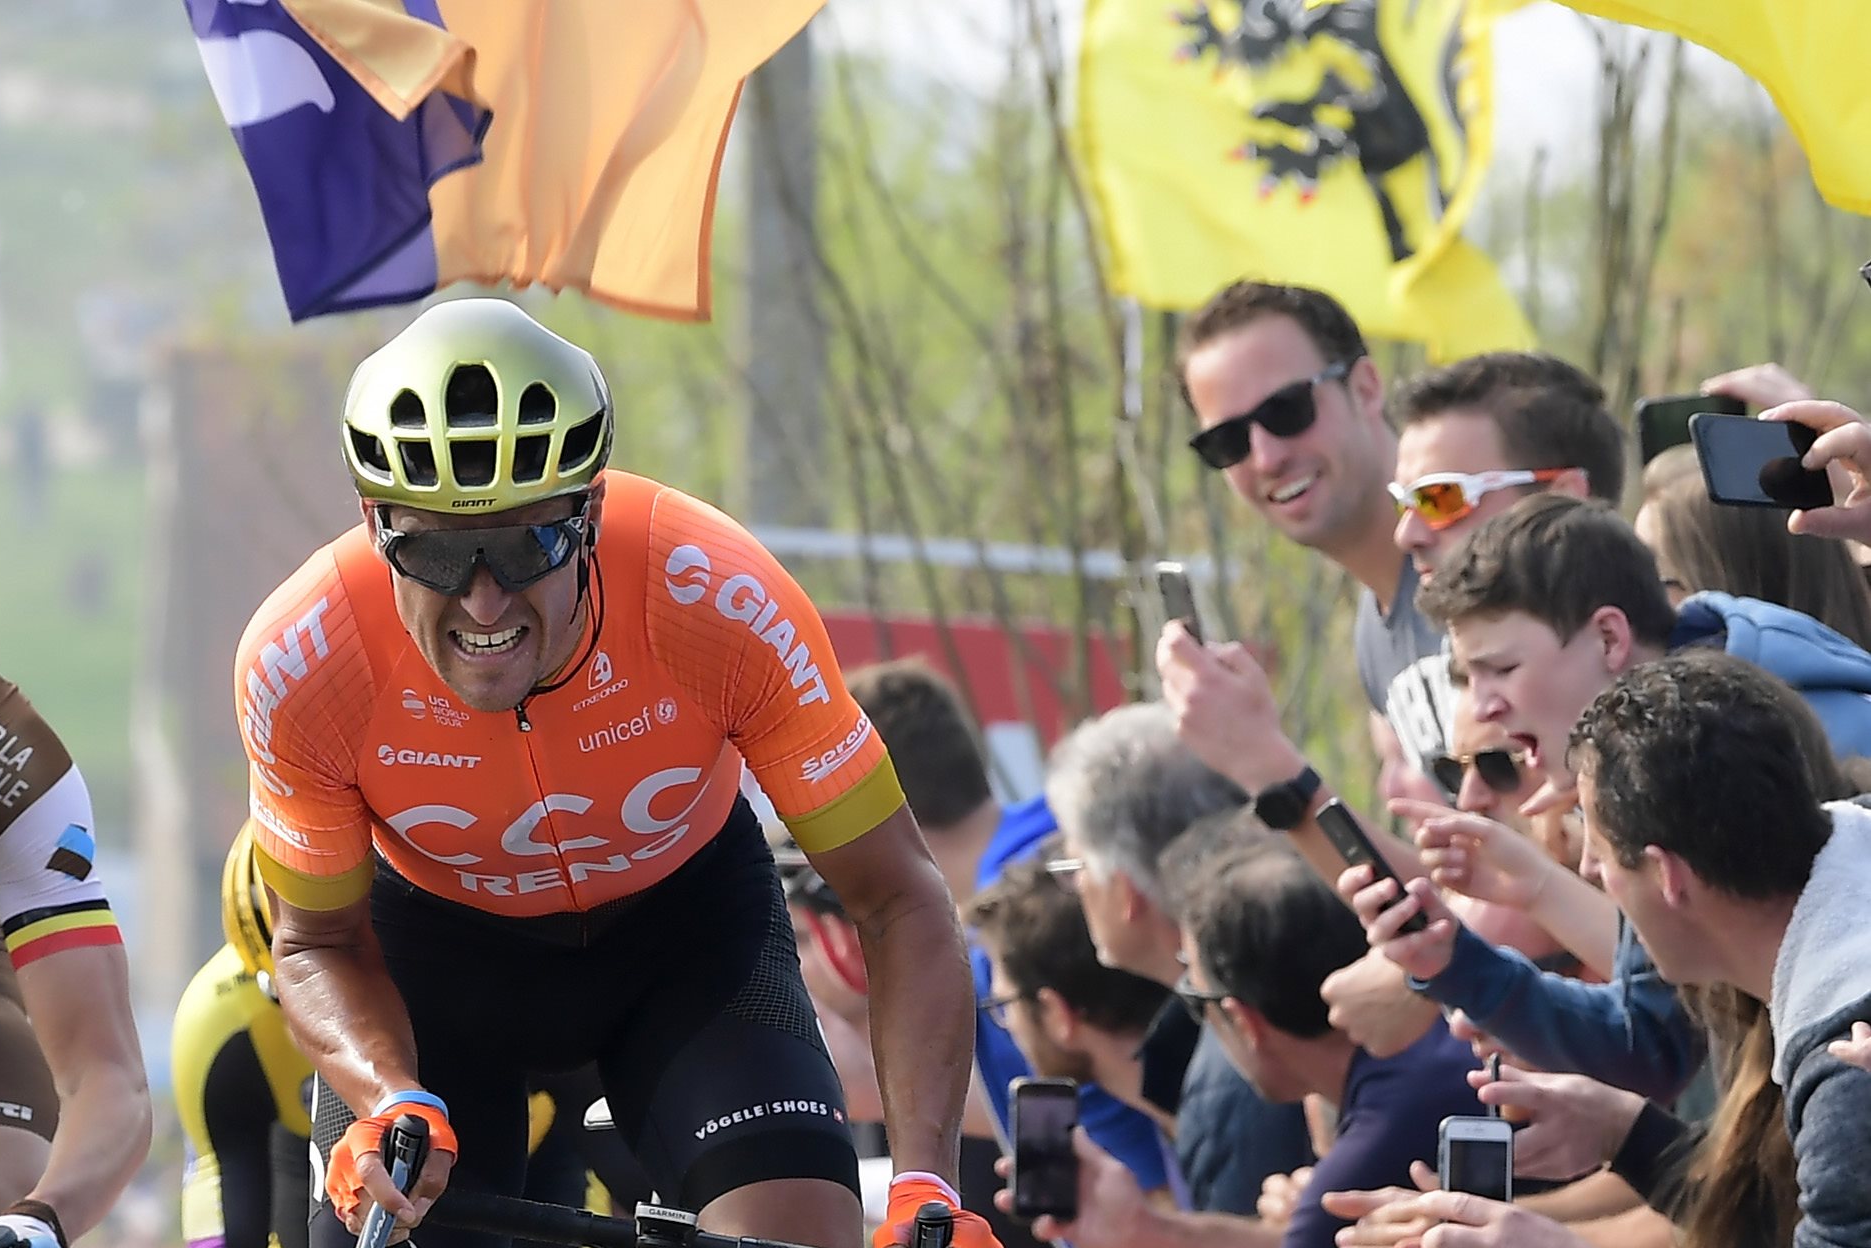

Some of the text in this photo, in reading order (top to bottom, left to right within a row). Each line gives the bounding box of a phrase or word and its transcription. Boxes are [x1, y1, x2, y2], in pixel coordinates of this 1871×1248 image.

[451, 498, 498, 508] GIANT
[714, 572, 831, 706] GIANT
[428, 694, 450, 708] UCI
[430, 705, 470, 721] WORLD
[433, 714, 464, 728] TOUR
[578, 705, 652, 753] unicef
[396, 749, 482, 769] GIANT
[385, 767, 707, 866] CCC
[771, 1100, 828, 1116] SHOES
[648, 1207, 686, 1220] GARMIN
